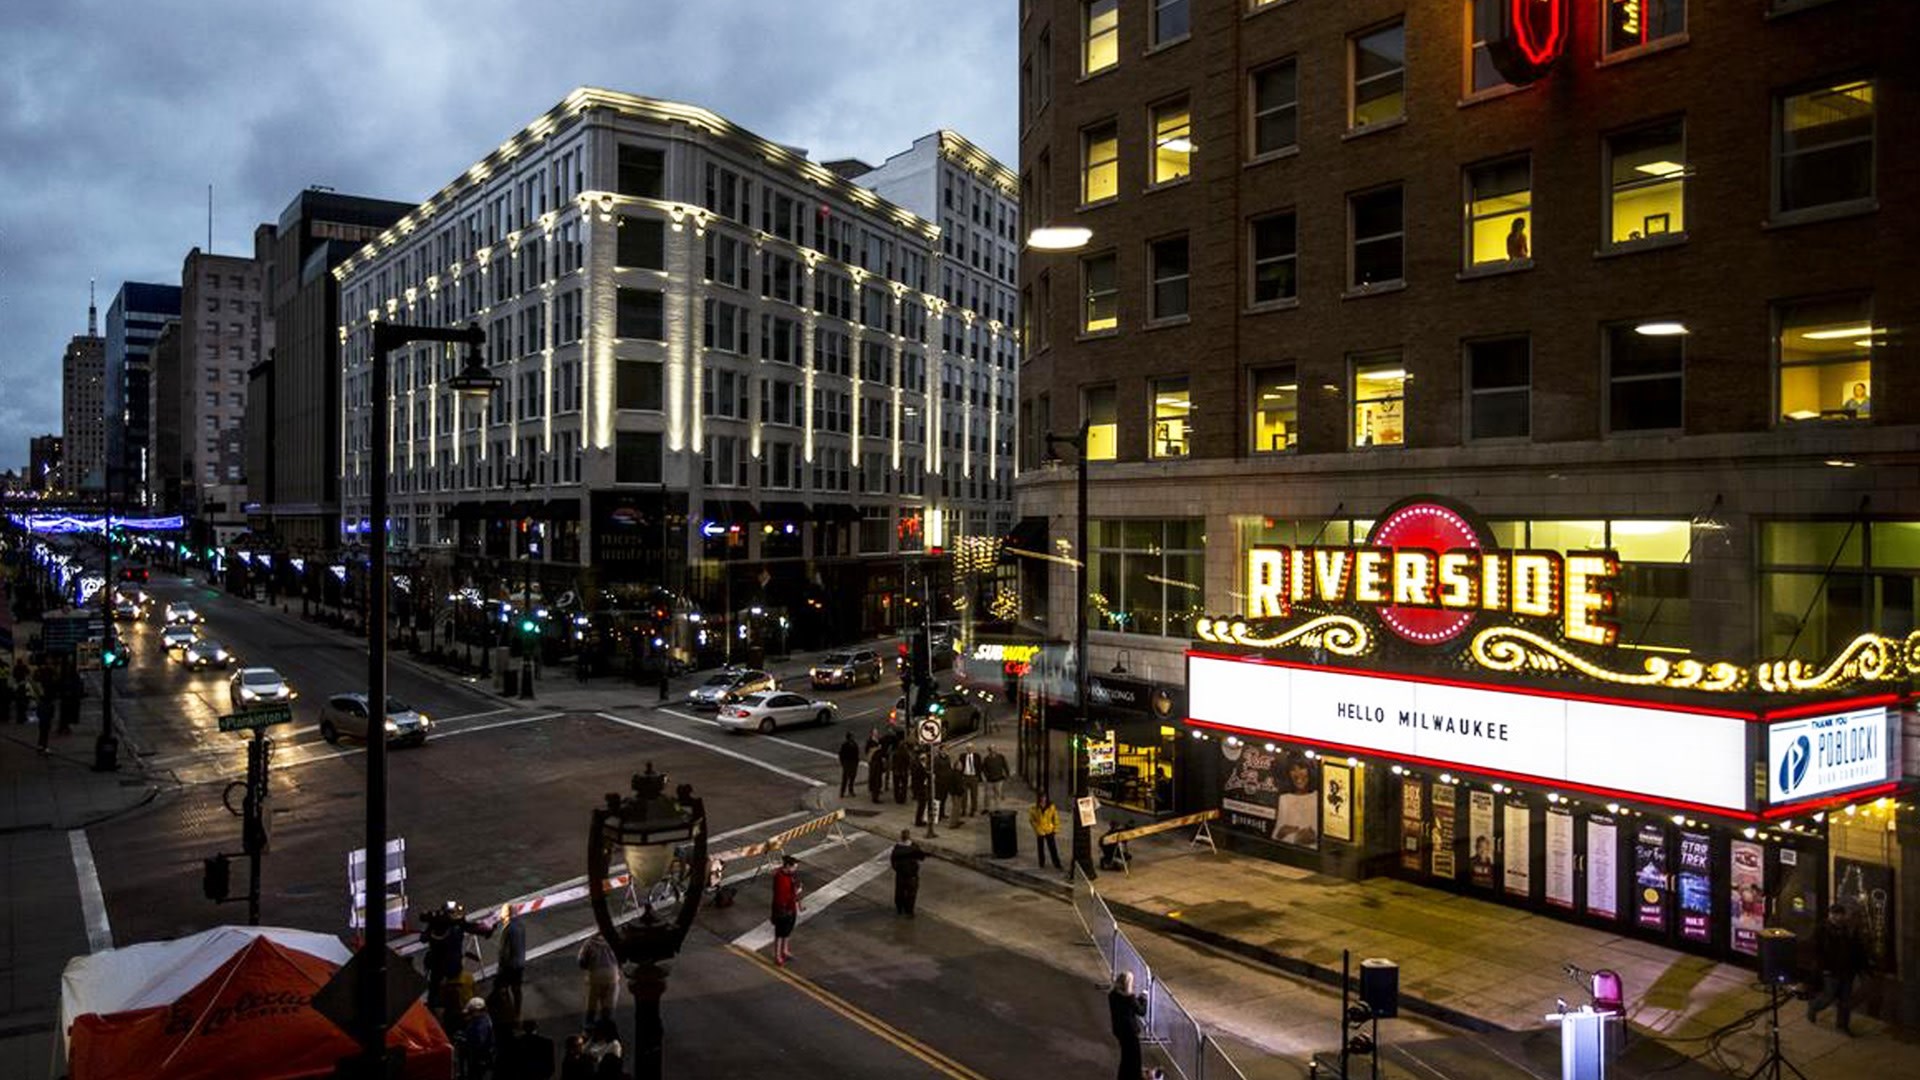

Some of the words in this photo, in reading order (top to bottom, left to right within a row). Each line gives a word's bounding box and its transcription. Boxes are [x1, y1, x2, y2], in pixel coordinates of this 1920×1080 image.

[1247, 544, 1621, 647] RIVERSIDE
[974, 644, 1039, 663] SUBWAY
[1337, 702, 1385, 724] HELLO
[1398, 709, 1509, 743] MILWAUKEE
[1811, 719, 1833, 730] THANK
[1835, 716, 1848, 727] YOU
[1818, 725, 1878, 768] POBLOCKI
[1680, 840, 1709, 853] STAR
[1680, 853, 1708, 869] TREK
